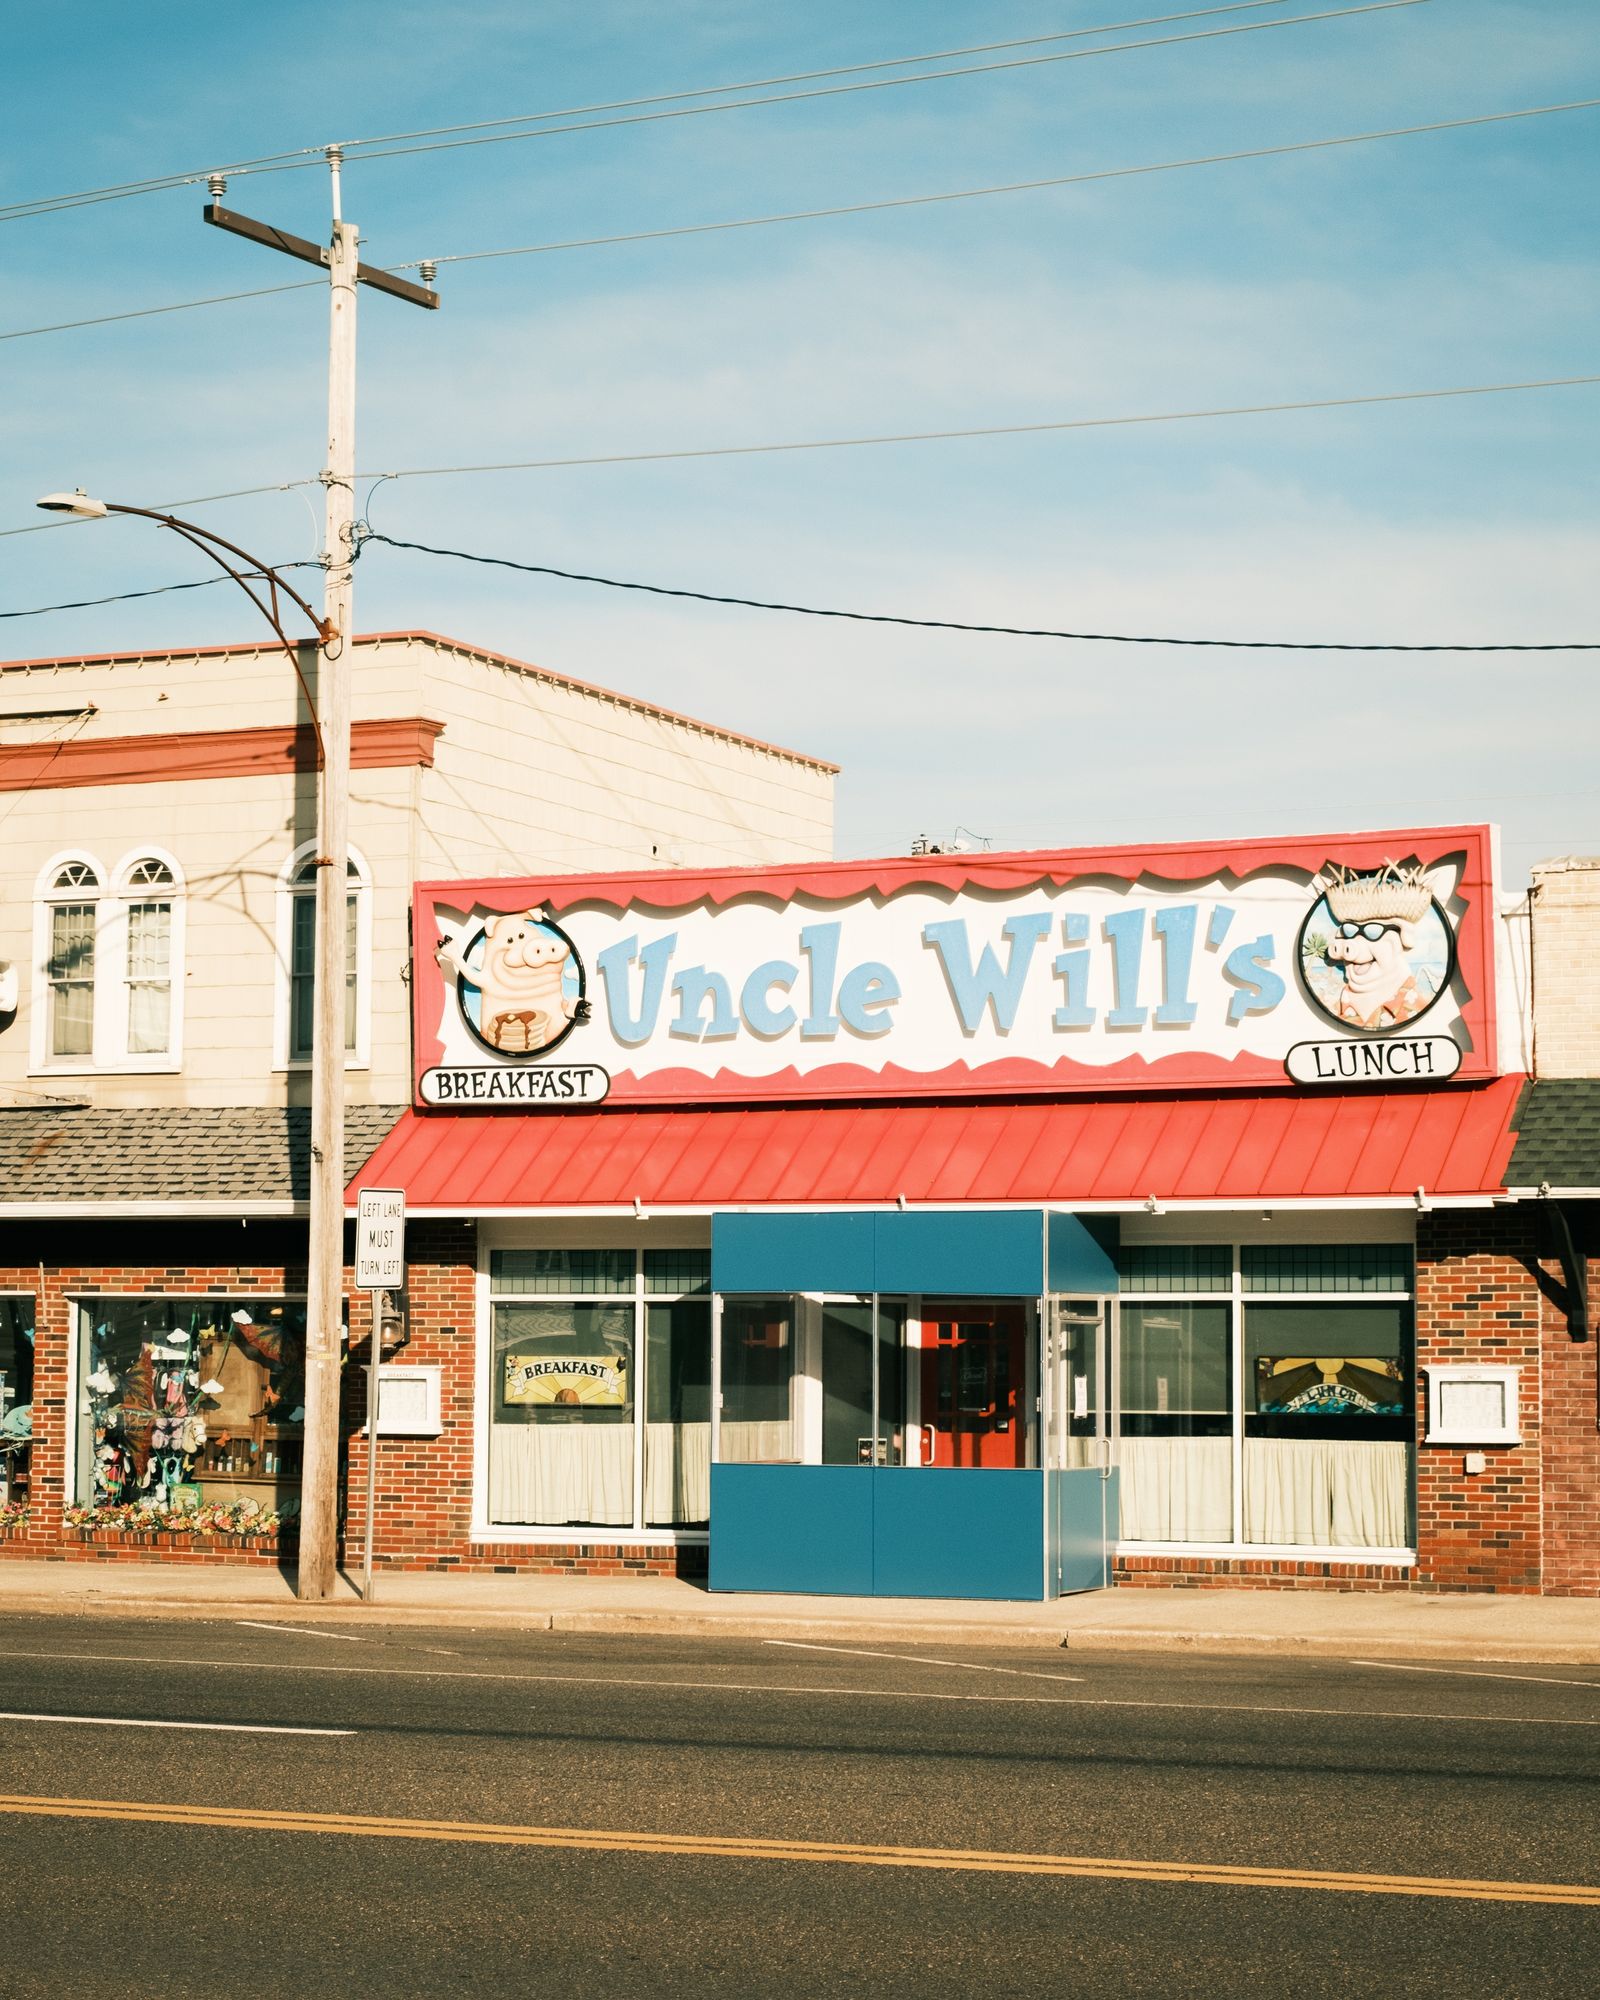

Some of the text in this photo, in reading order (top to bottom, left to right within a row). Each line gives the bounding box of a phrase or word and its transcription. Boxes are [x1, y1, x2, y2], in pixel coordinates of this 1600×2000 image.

[597, 904, 1286, 1043] Uncle Will's
[1312, 1042, 1434, 1077] LUNCH
[435, 1069, 594, 1099] BREAKFAST
[363, 1202, 401, 1218] LEFT LANE
[369, 1230, 394, 1248] MUST
[361, 1260, 400, 1275] TURN LEFT
[524, 1361, 608, 1380] BREAKFAST
[1307, 1384, 1358, 1401] LUNCH
